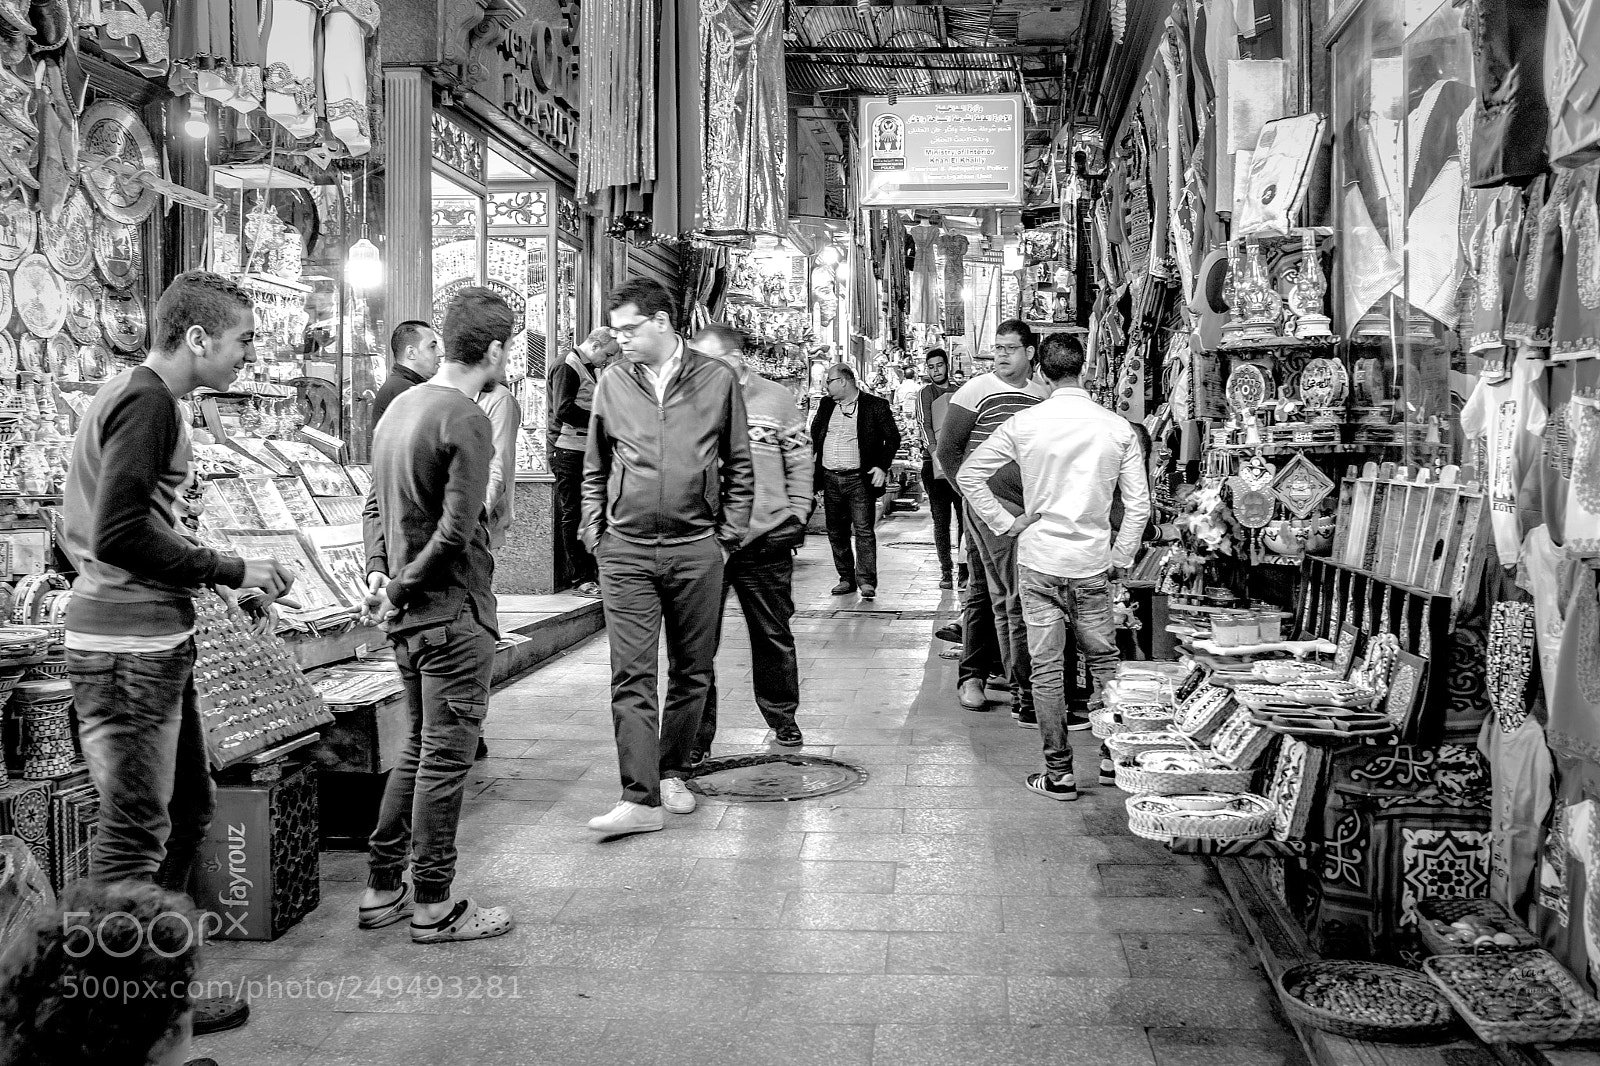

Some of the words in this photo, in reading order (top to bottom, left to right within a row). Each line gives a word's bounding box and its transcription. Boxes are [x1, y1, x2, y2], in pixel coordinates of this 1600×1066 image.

[966, 148, 994, 156] Interior
[1076, 652, 1087, 689] PEPSI
[218, 823, 254, 908] fayrouz
